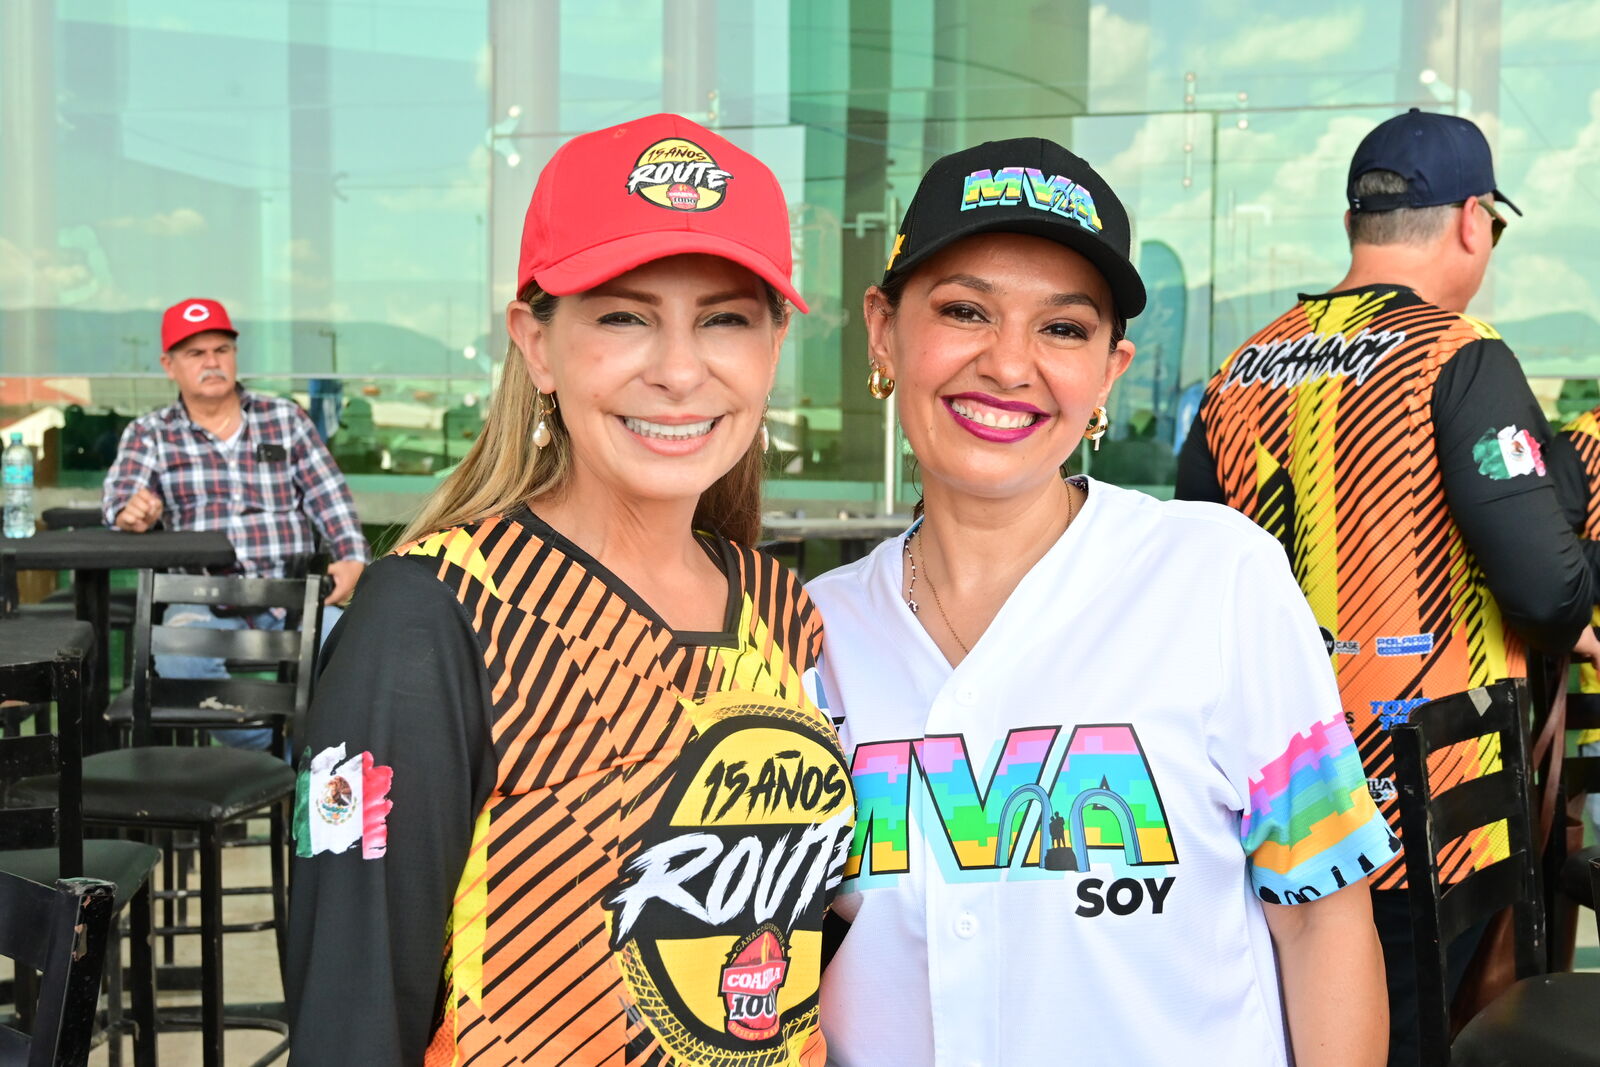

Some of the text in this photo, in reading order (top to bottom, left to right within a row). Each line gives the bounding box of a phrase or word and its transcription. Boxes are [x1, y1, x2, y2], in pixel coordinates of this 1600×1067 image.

[648, 146, 707, 163] 15 AÑOS
[625, 160, 735, 195] ROUTE
[961, 167, 1103, 233] MVA
[183, 303, 210, 322] C
[701, 749, 847, 825] 15 AÑOS
[1075, 876, 1177, 918] SOY
[730, 988, 777, 1020] 100
